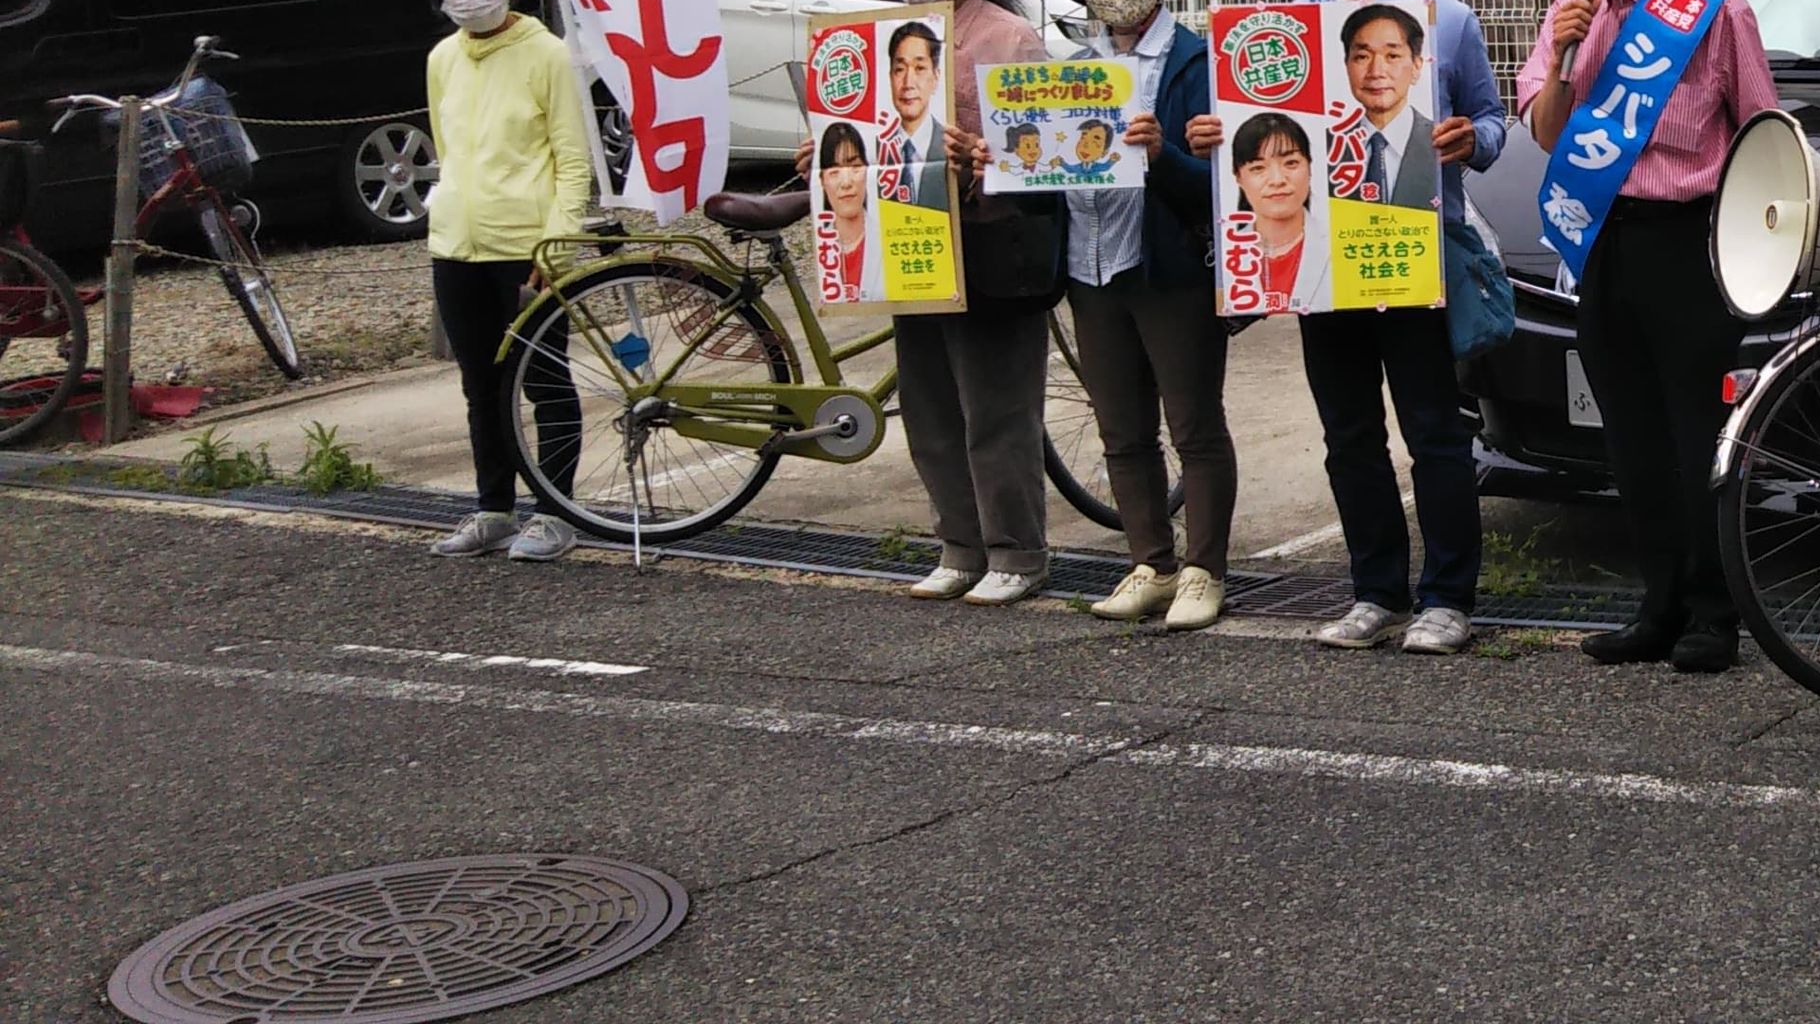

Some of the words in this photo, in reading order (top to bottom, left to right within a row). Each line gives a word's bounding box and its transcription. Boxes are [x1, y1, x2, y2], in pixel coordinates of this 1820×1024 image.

[1246, 37, 1285, 64] 日本
[828, 55, 852, 77] 日本
[1243, 57, 1304, 90] 共産党
[824, 72, 865, 100] 共産党
[878, 111, 903, 198] シバタ
[1328, 101, 1367, 196] シバタ
[1338, 226, 1430, 239] とりのこさない政治で
[817, 213, 841, 301] こむら
[890, 239, 944, 256] ささえ合う
[1343, 241, 1426, 260] ささえ合う
[900, 258, 935, 275] 社会を
[1226, 213, 1261, 311] こむら
[1359, 261, 1410, 279] 社会を
